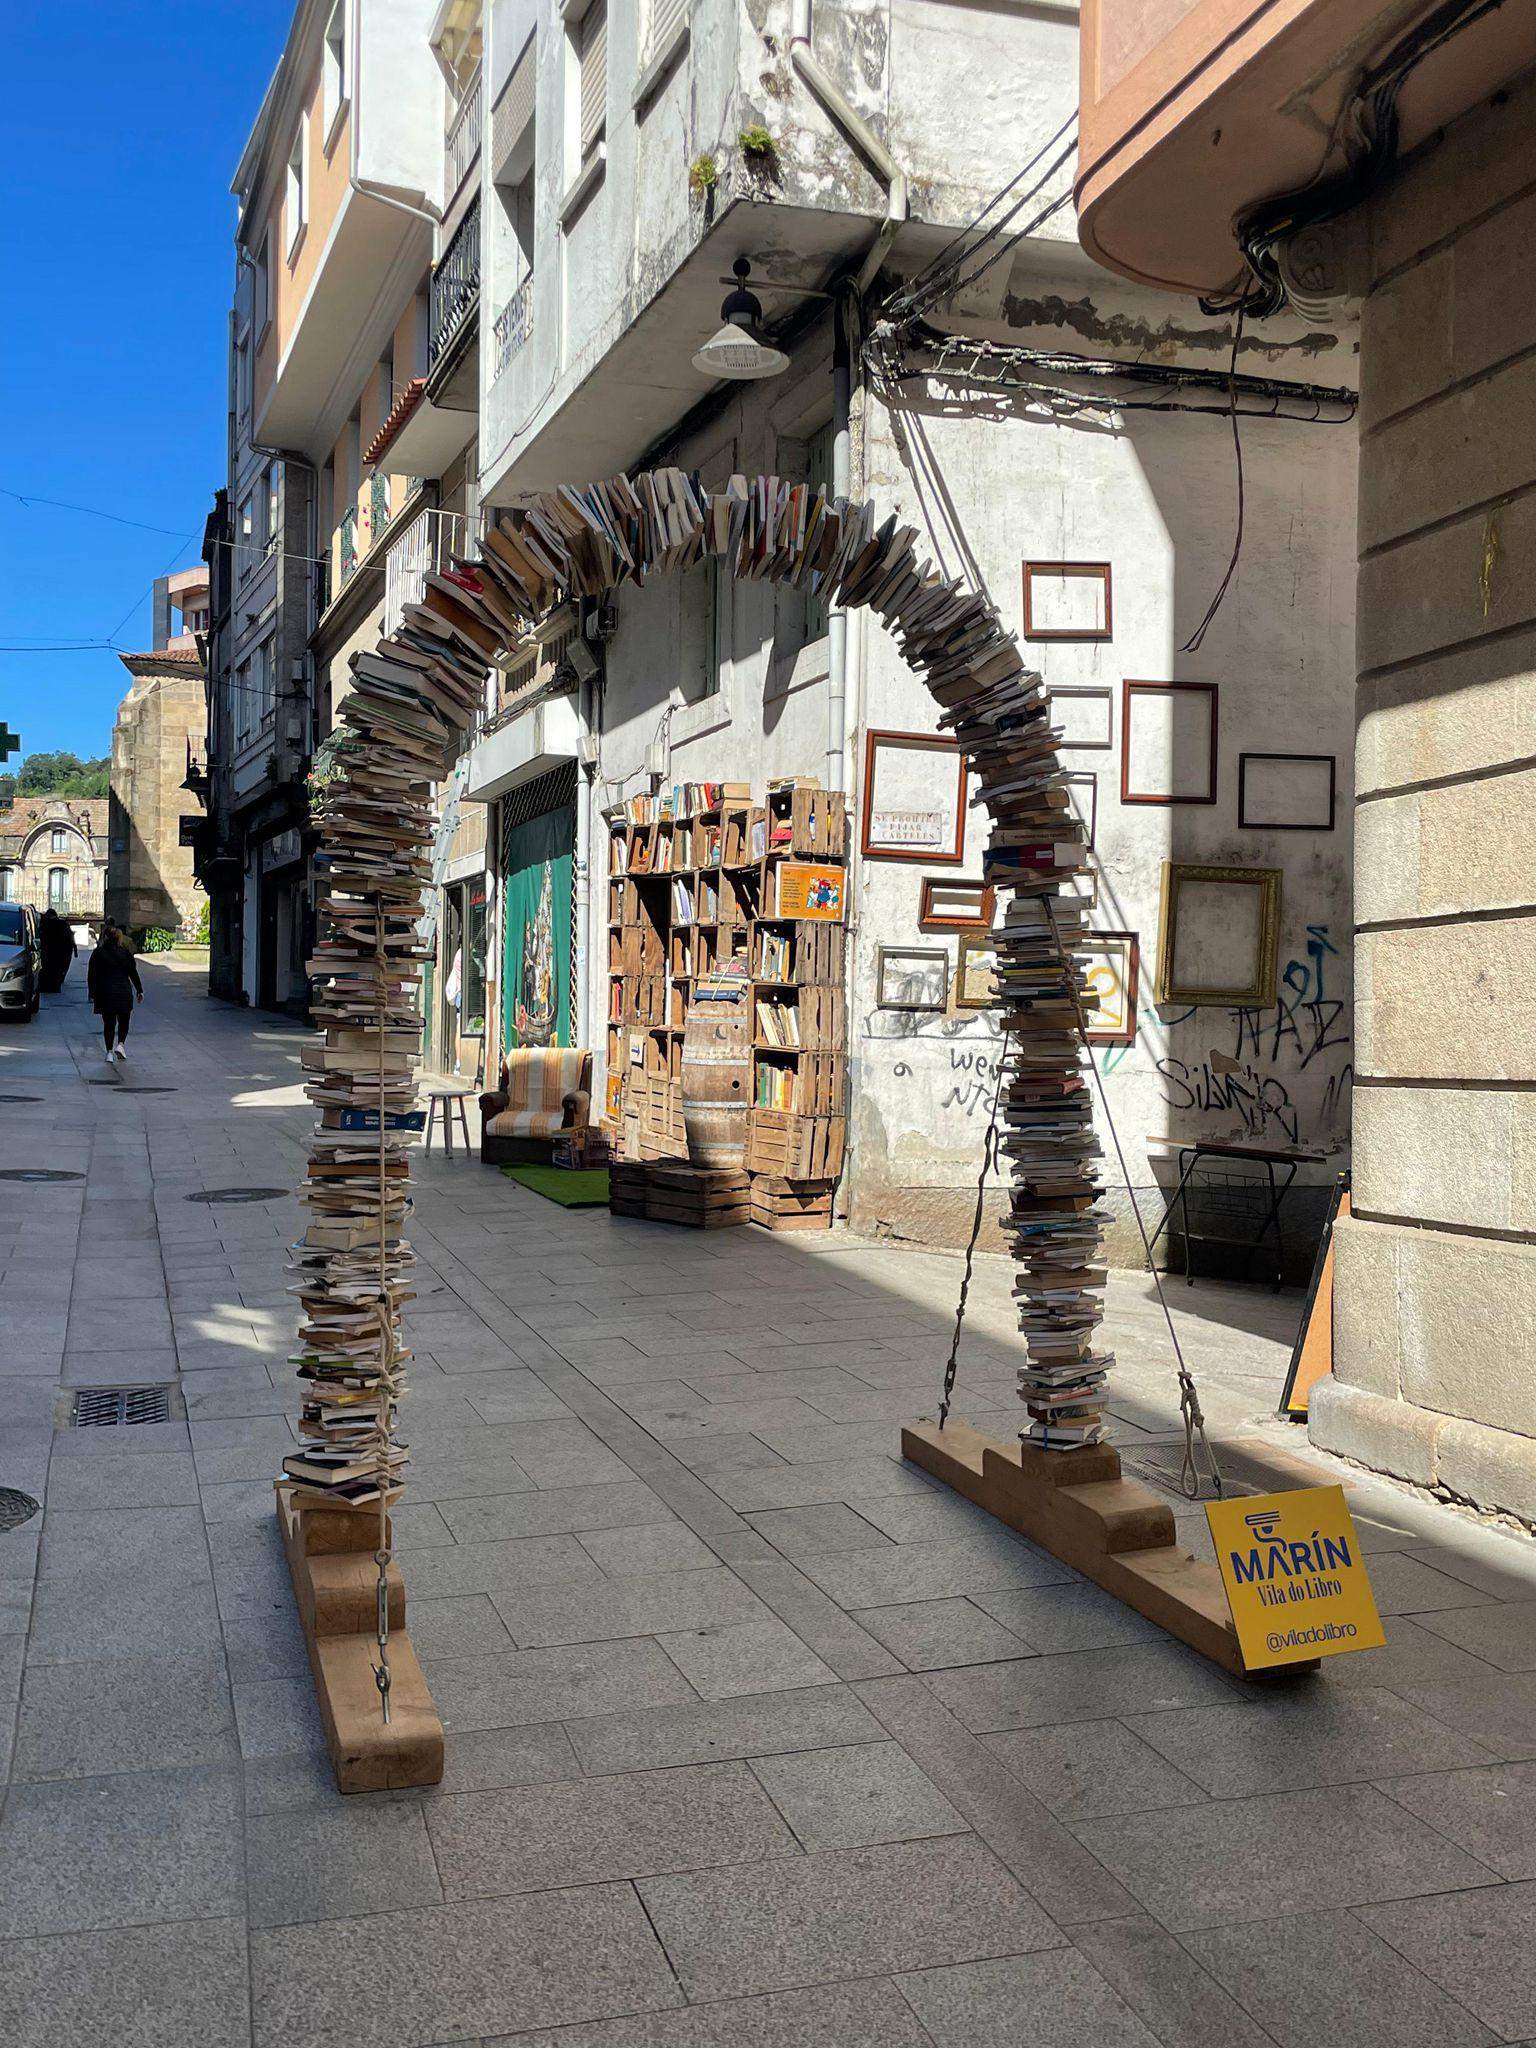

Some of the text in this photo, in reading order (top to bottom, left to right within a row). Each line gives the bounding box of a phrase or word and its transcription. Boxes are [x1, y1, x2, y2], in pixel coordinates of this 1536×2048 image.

[1230, 1531, 1352, 1584] MARÍN
[1257, 1577, 1342, 1607] Vila do Libro
[1266, 1622, 1357, 1653] @viladolibro
